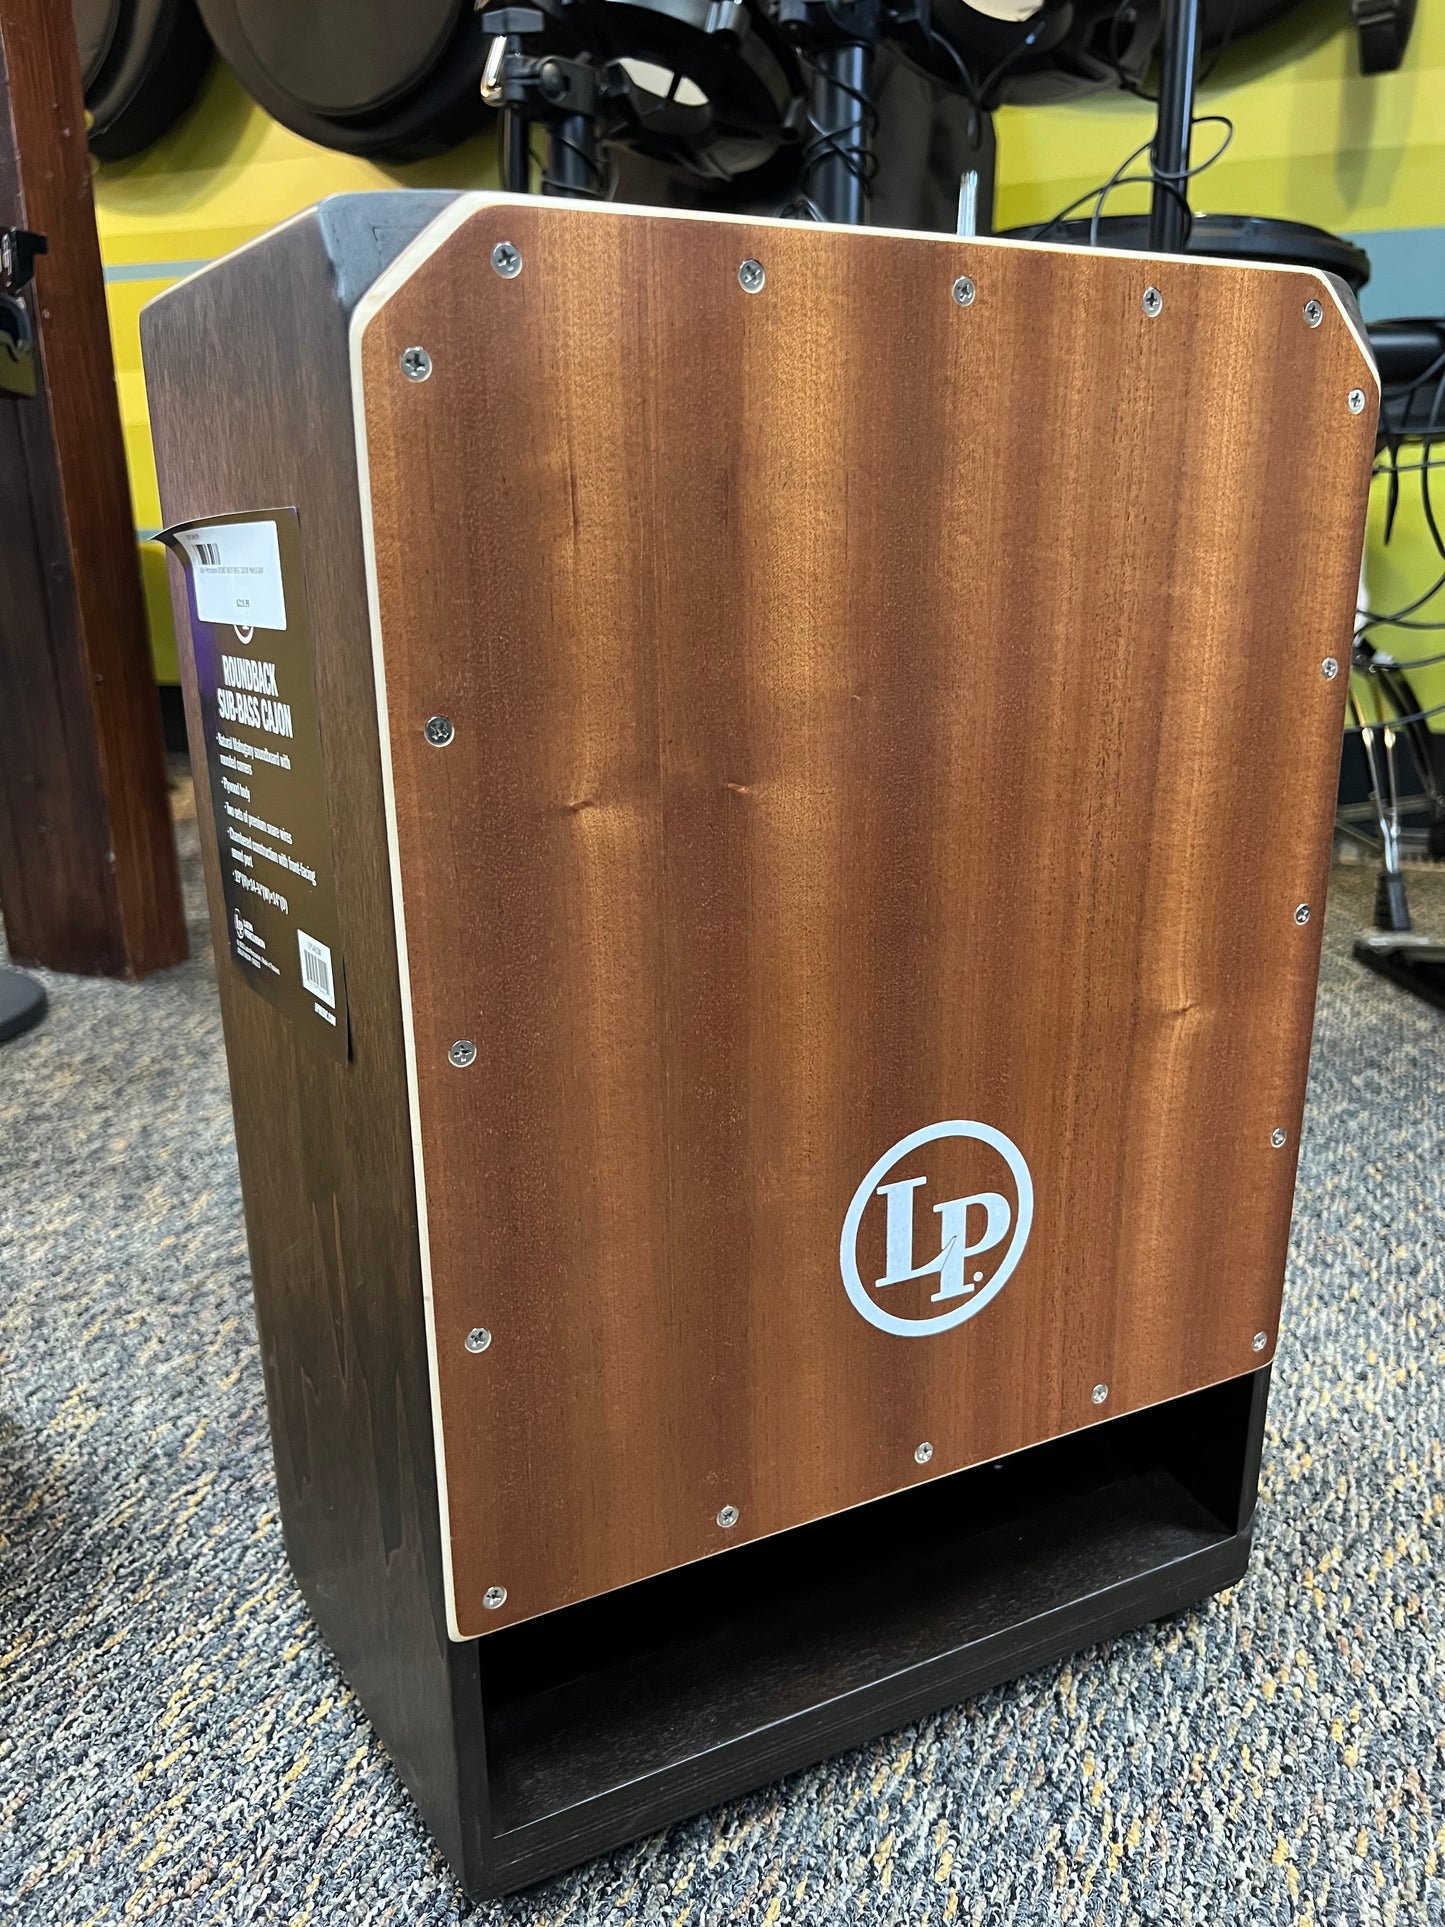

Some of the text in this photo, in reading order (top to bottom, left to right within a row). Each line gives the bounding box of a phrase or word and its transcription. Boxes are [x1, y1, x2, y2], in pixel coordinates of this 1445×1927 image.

[222, 655, 279, 697] ROUNDBACK
[217, 688, 293, 738] SUB-BASS CAJON
